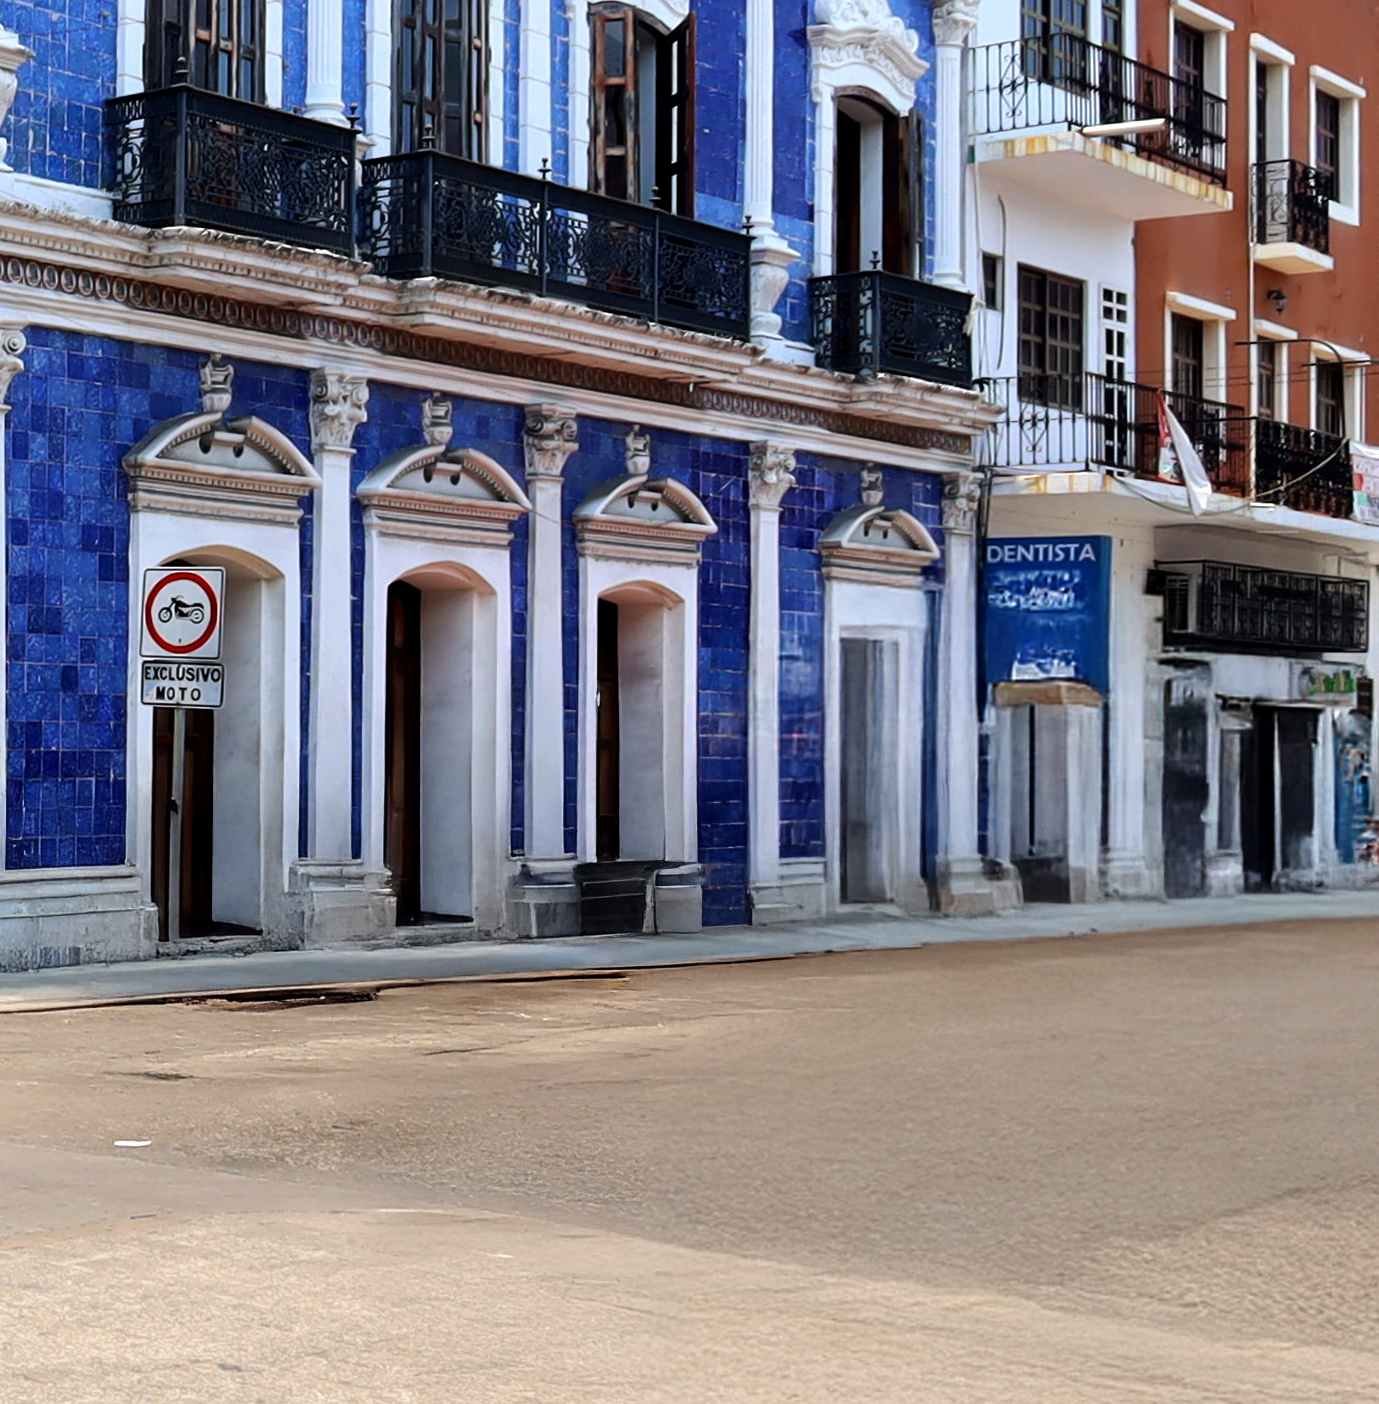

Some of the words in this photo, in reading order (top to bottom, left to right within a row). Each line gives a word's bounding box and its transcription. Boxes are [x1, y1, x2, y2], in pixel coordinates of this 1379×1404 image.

[986, 543, 1097, 563] DENTISTA
[144, 665, 221, 683] EXCLUSIVO
[155, 686, 201, 701] MOTO
